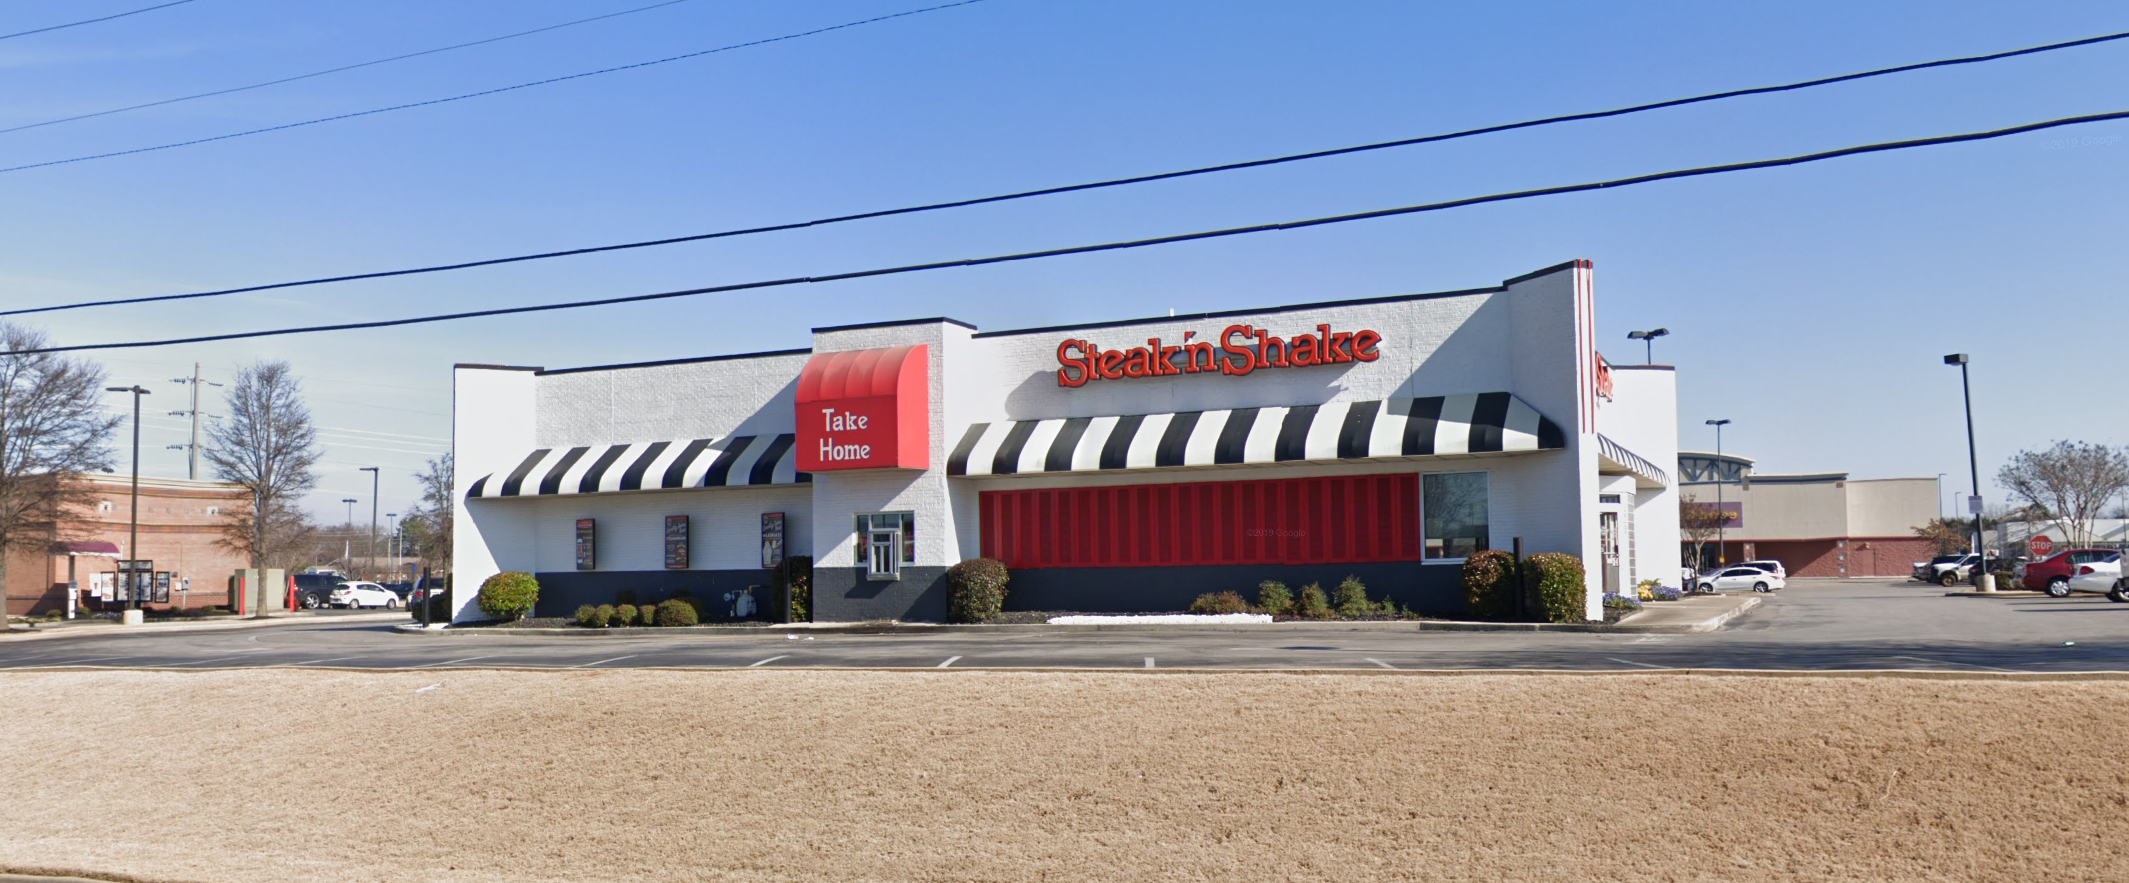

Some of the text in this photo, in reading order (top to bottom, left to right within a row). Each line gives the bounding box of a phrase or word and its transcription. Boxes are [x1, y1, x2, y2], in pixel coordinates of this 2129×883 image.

[1221, 323, 1382, 376] Shake
[822, 407, 869, 432] Take
[819, 437, 871, 462] Home
[2031, 541, 2052, 550] STOP
